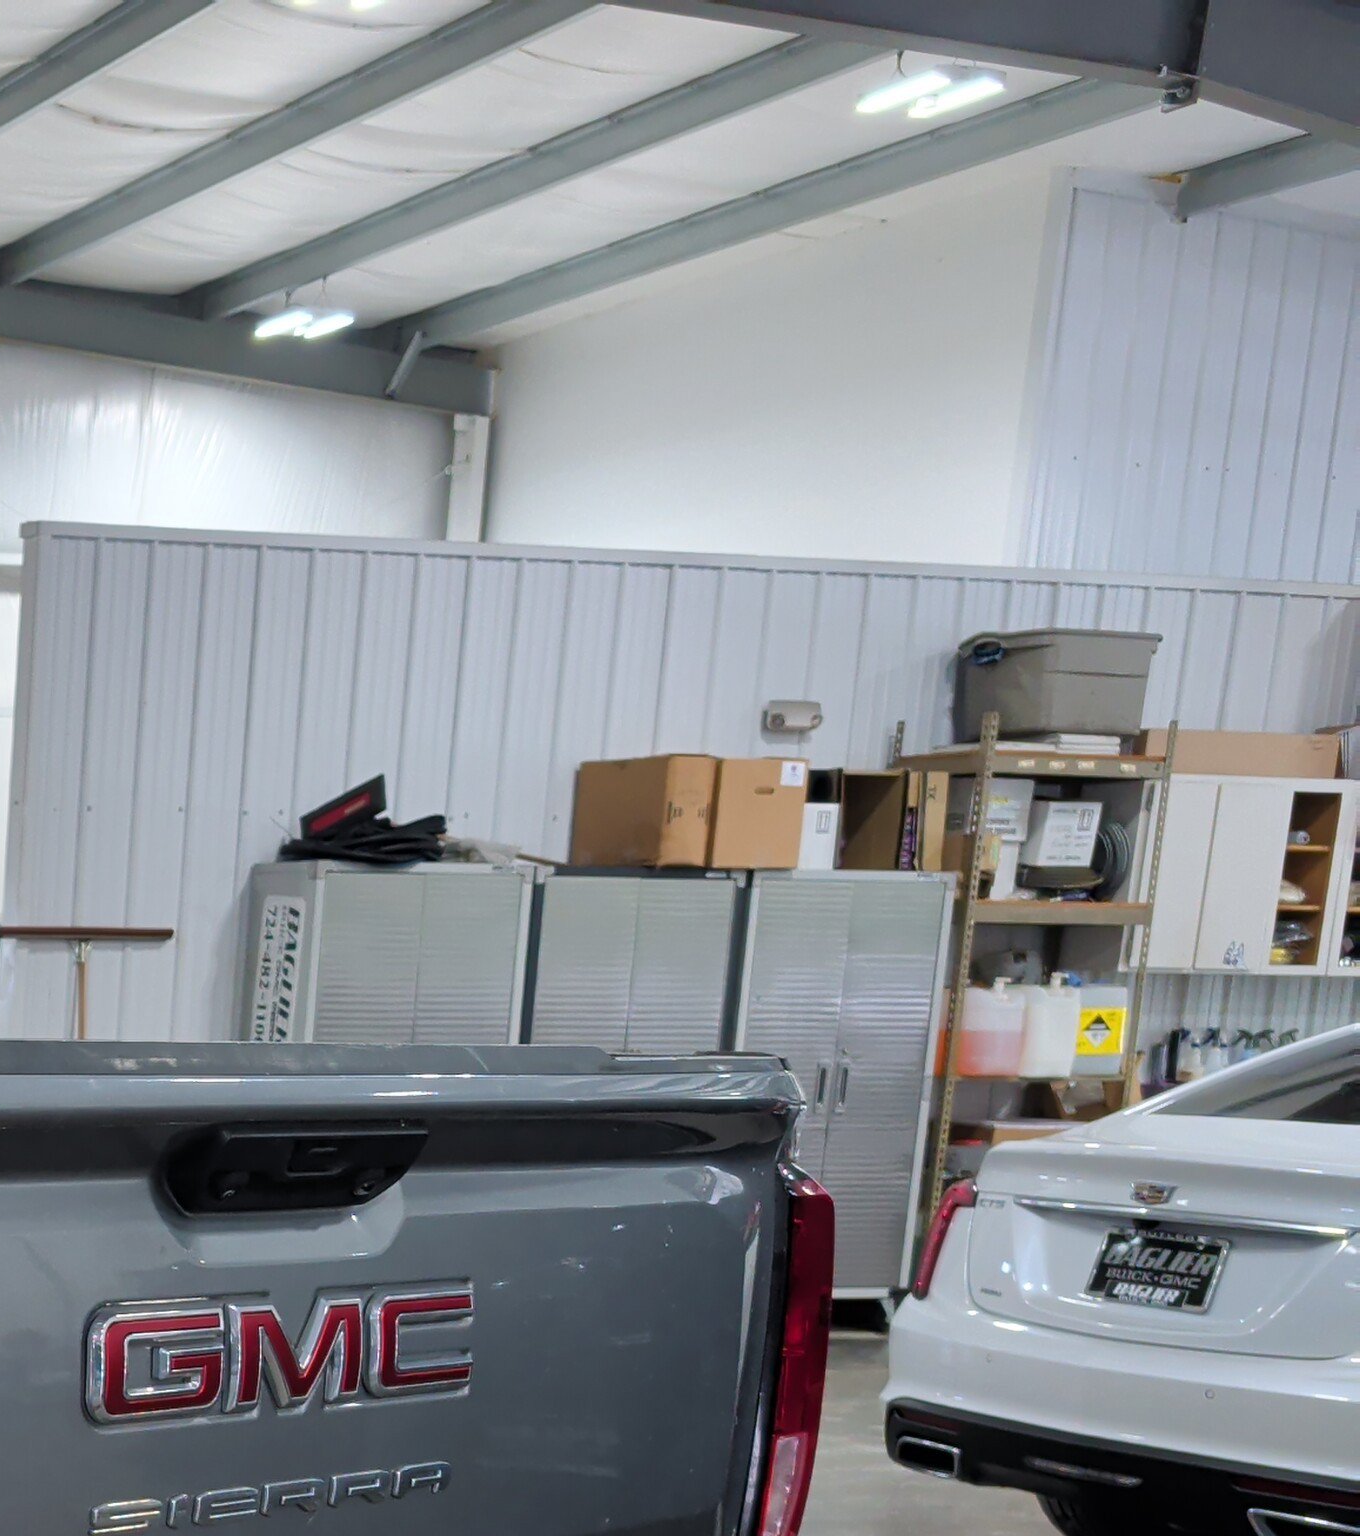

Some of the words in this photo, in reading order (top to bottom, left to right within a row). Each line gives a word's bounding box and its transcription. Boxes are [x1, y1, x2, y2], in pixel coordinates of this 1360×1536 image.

[1104, 1243, 1219, 1278] BAGLIER
[85, 1280, 474, 1432] GMC
[88, 1461, 452, 1536] SIERRA
